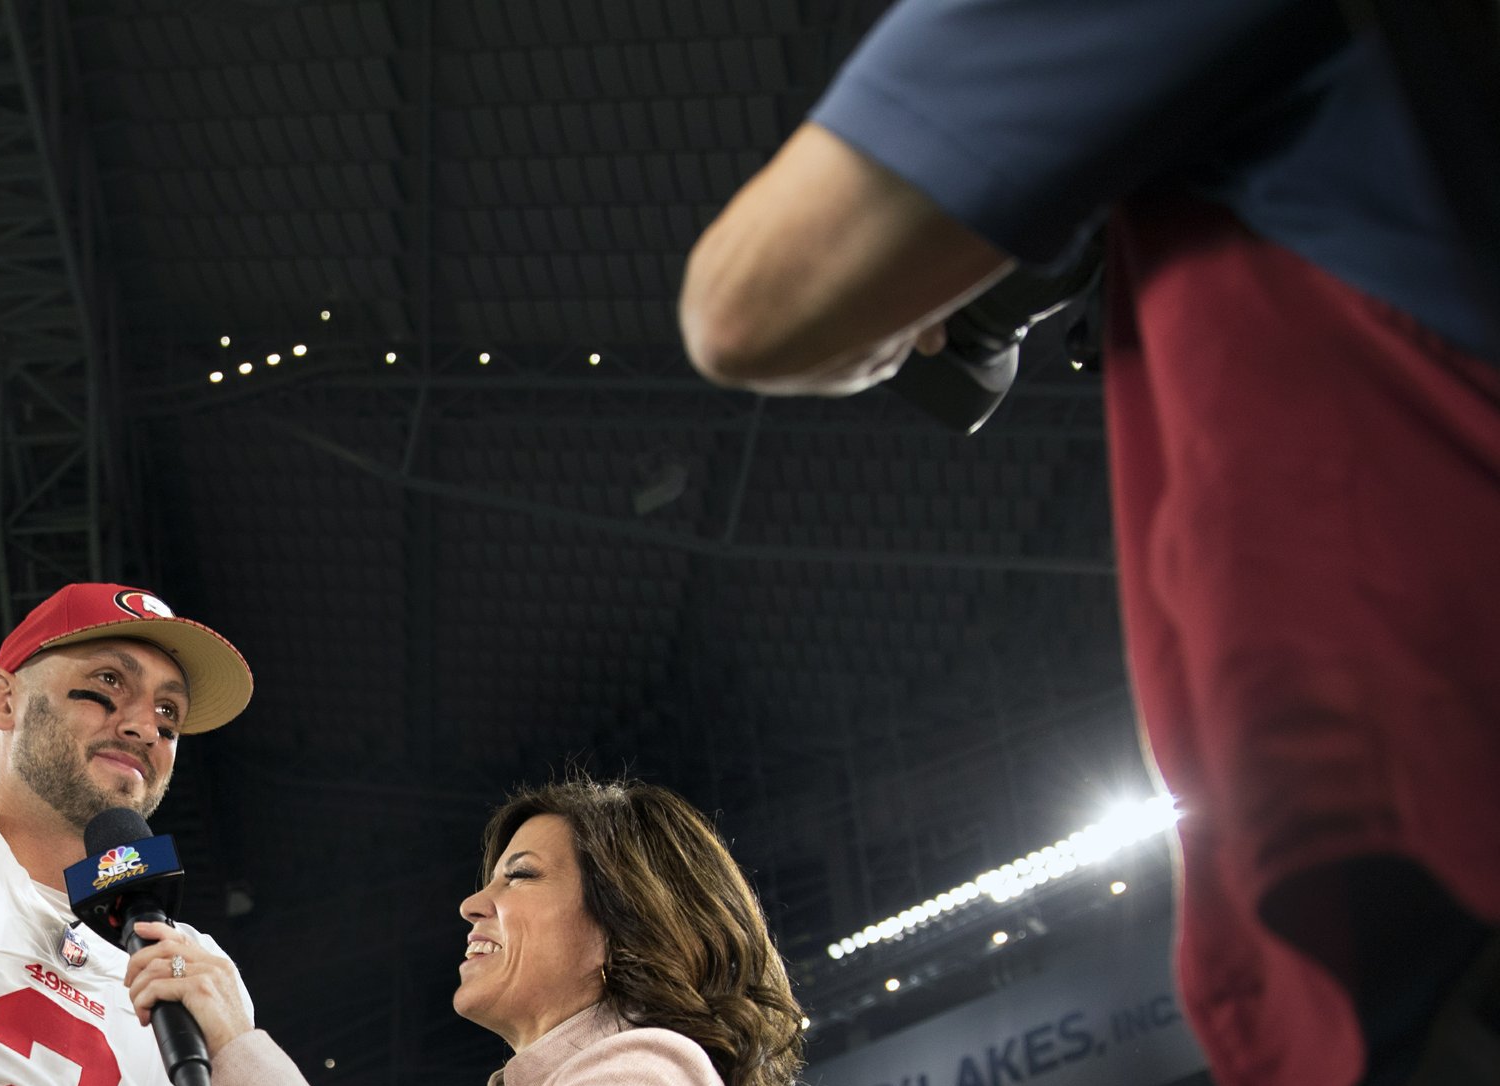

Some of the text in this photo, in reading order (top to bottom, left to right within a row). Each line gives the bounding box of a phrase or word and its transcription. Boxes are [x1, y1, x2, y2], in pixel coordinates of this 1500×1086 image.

[92, 864, 149, 891] Sports
[98, 857, 143, 880] NBC
[25, 963, 105, 1018] 49ERS
